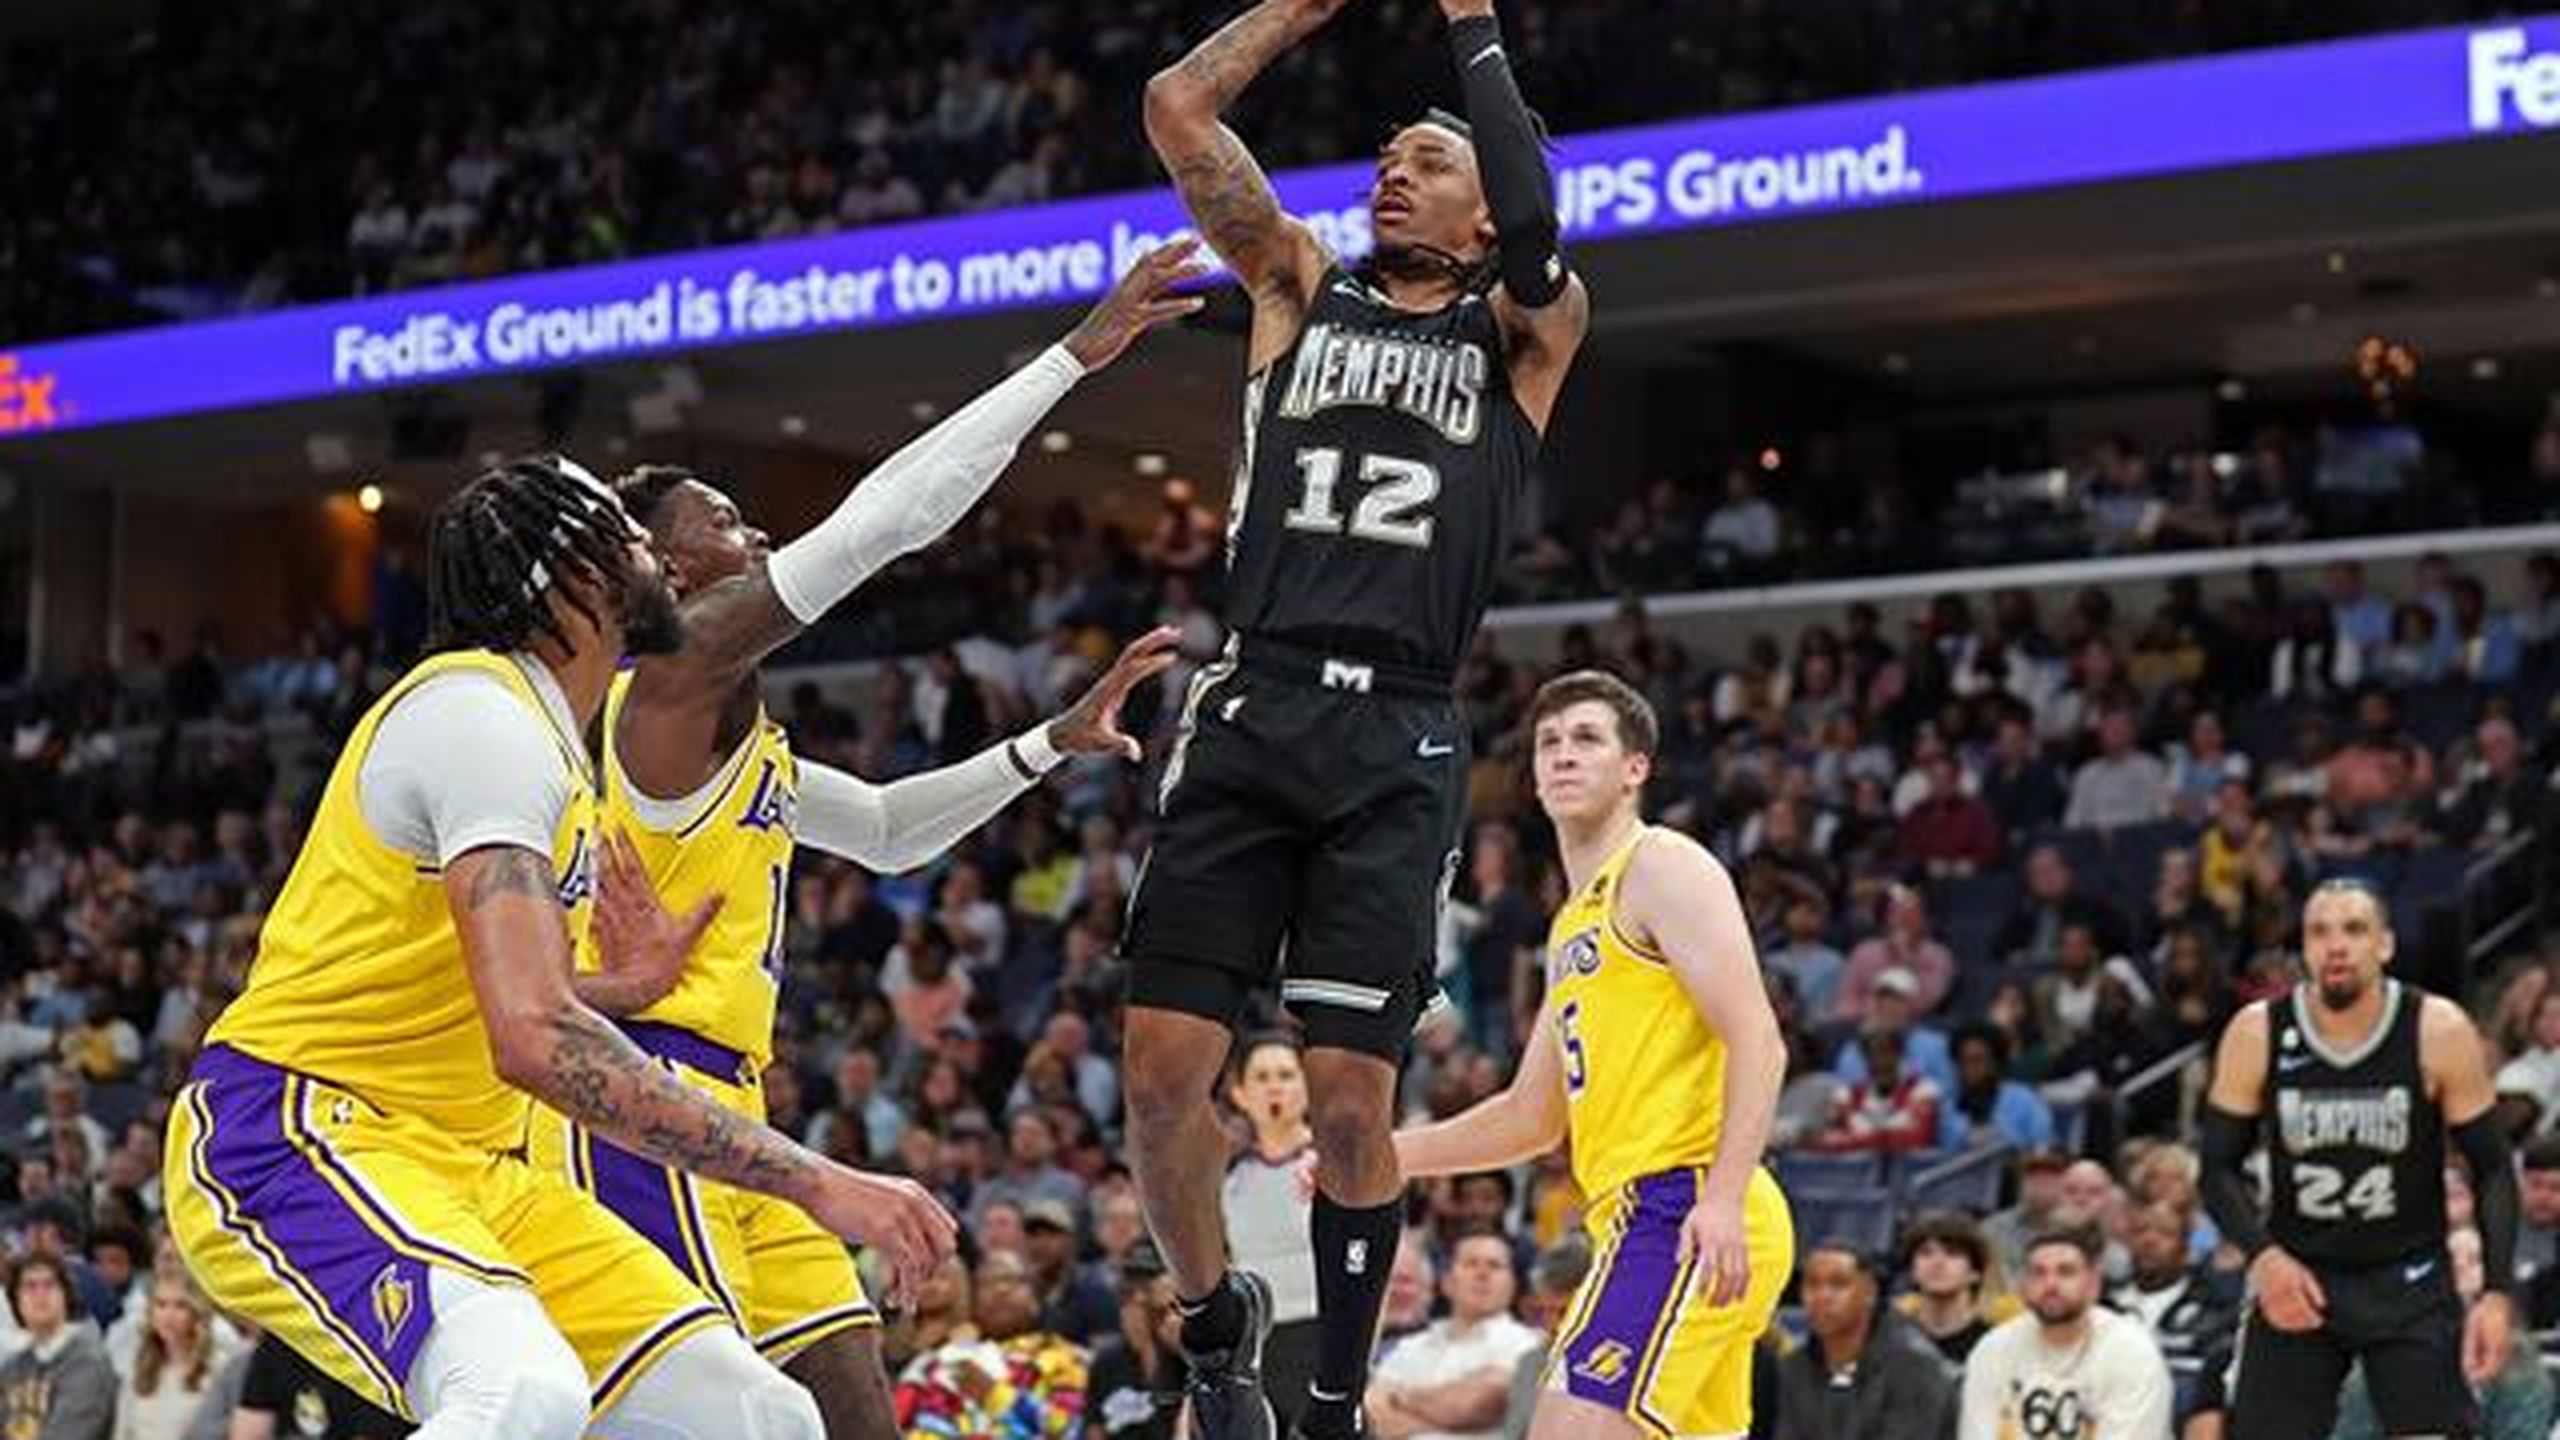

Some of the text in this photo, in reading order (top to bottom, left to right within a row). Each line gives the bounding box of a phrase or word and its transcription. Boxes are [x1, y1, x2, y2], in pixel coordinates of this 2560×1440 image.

[333, 312, 479, 384] FedEx
[485, 279, 673, 363] Ground
[678, 276, 721, 341] is
[728, 269, 883, 332] faster
[892, 253, 953, 312] to
[956, 238, 1104, 304] more
[1665, 125, 1923, 218] Ground.
[1278, 322, 1486, 445] MEMPHIS
[1283, 446, 1441, 549] 12
[2277, 1085, 2410, 1155] MEMPHIS
[2293, 1162, 2398, 1222] 24
[2021, 1387, 2082, 1440] 60
